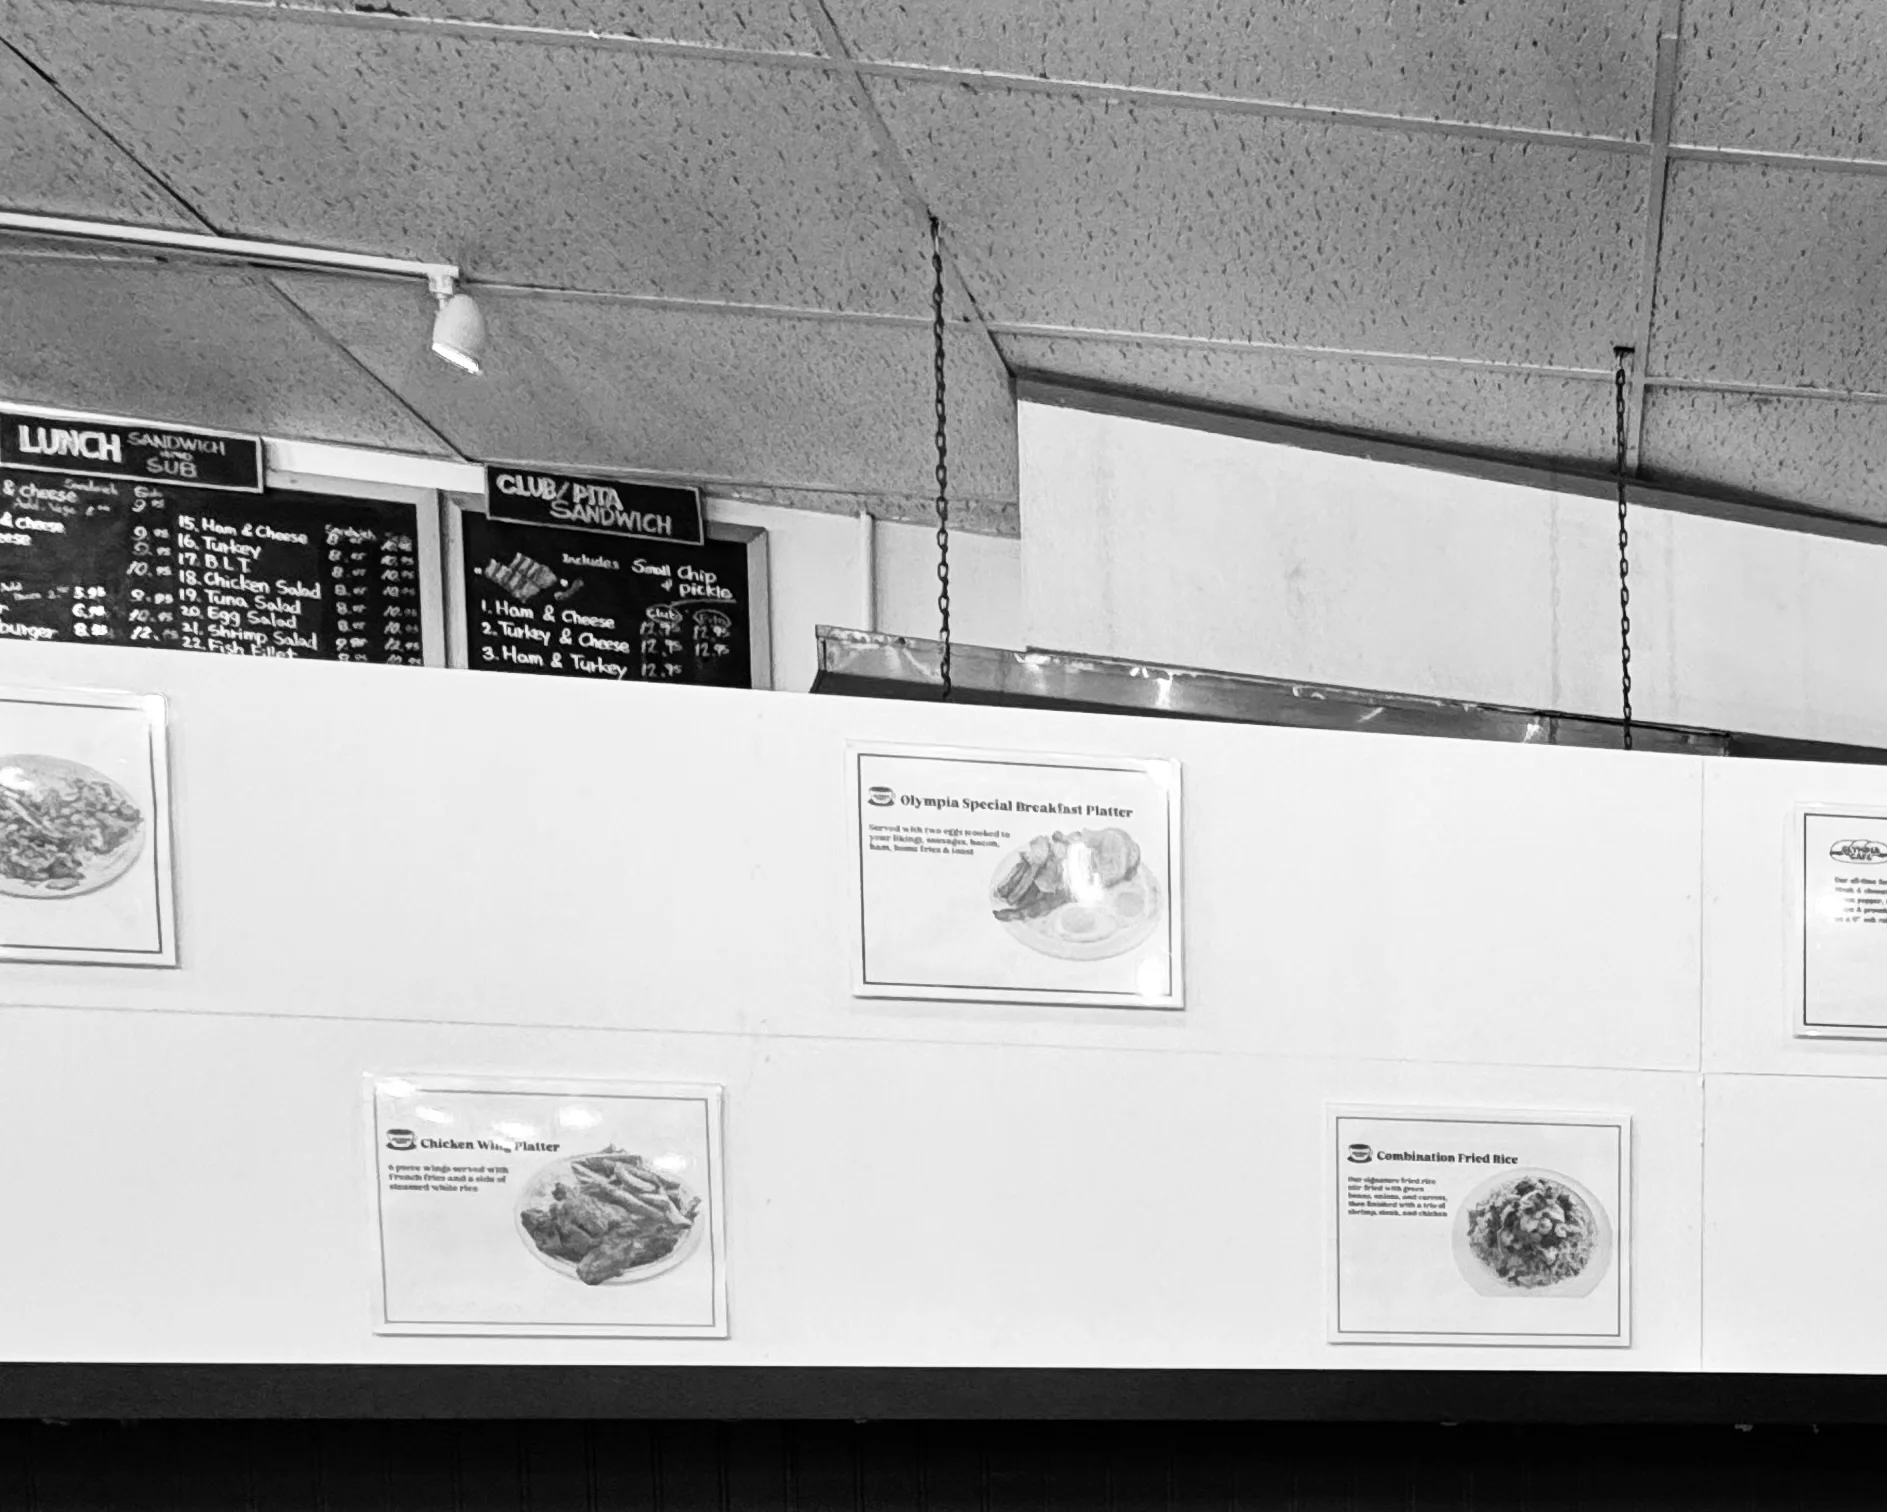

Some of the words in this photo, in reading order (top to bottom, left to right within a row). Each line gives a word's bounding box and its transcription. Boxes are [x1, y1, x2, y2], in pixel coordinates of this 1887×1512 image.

[18, 425, 122, 463] LUNCH
[127, 432, 226, 456] SANDWICH
[146, 457, 197, 478] SUB
[178, 514, 200, 533] 15.
[201, 517, 238, 536] Ham
[241, 523, 253, 537] &
[255, 525, 308, 544] Cheese
[549, 499, 673, 536] SANDWICH
[178, 533, 200, 550] 16.
[201, 536, 262, 560] Turkey
[562, 553, 620, 570] Includes
[631, 558, 671, 577] Small
[179, 569, 202, 586] 18.
[203, 572, 270, 594] Chicken
[275, 579, 321, 600] Salad
[179, 588, 201, 603] 19.
[203, 589, 249, 608] Tuna
[254, 595, 302, 615] Salad
[481, 599, 492, 615] 1.
[495, 600, 534, 620] Ham
[543, 604, 556, 622] &
[562, 609, 615, 629] Cheese
[180, 605, 204, 619] 20.
[207, 606, 241, 628] Egg
[247, 610, 297, 630] Salad
[181, 621, 204, 636] 21.
[207, 623, 268, 646] Shrimp
[273, 630, 319, 651] Salad
[181, 636, 206, 652] 22.
[208, 638, 245, 655] Fish
[481, 621, 499, 636] 2.
[498, 620, 552, 646] Turkey
[559, 627, 572, 645] &
[578, 632, 631, 654] Cheese
[481, 645, 500, 661] 3.
[502, 645, 545, 667] Ham
[550, 652, 563, 668] &
[569, 653, 628, 680] Turkey
[900, 794, 960, 810] Olympia
[963, 798, 1012, 812] Special
[1016, 801, 1083, 815] Breakfast
[1086, 805, 1134, 818] Platter
[420, 1138, 474, 1150] Chicken
[514, 1141, 560, 1152] Platter
[1376, 1150, 1456, 1163] Combination
[1458, 1153, 1490, 1164] Fried
[1493, 1154, 1519, 1164] Rice
